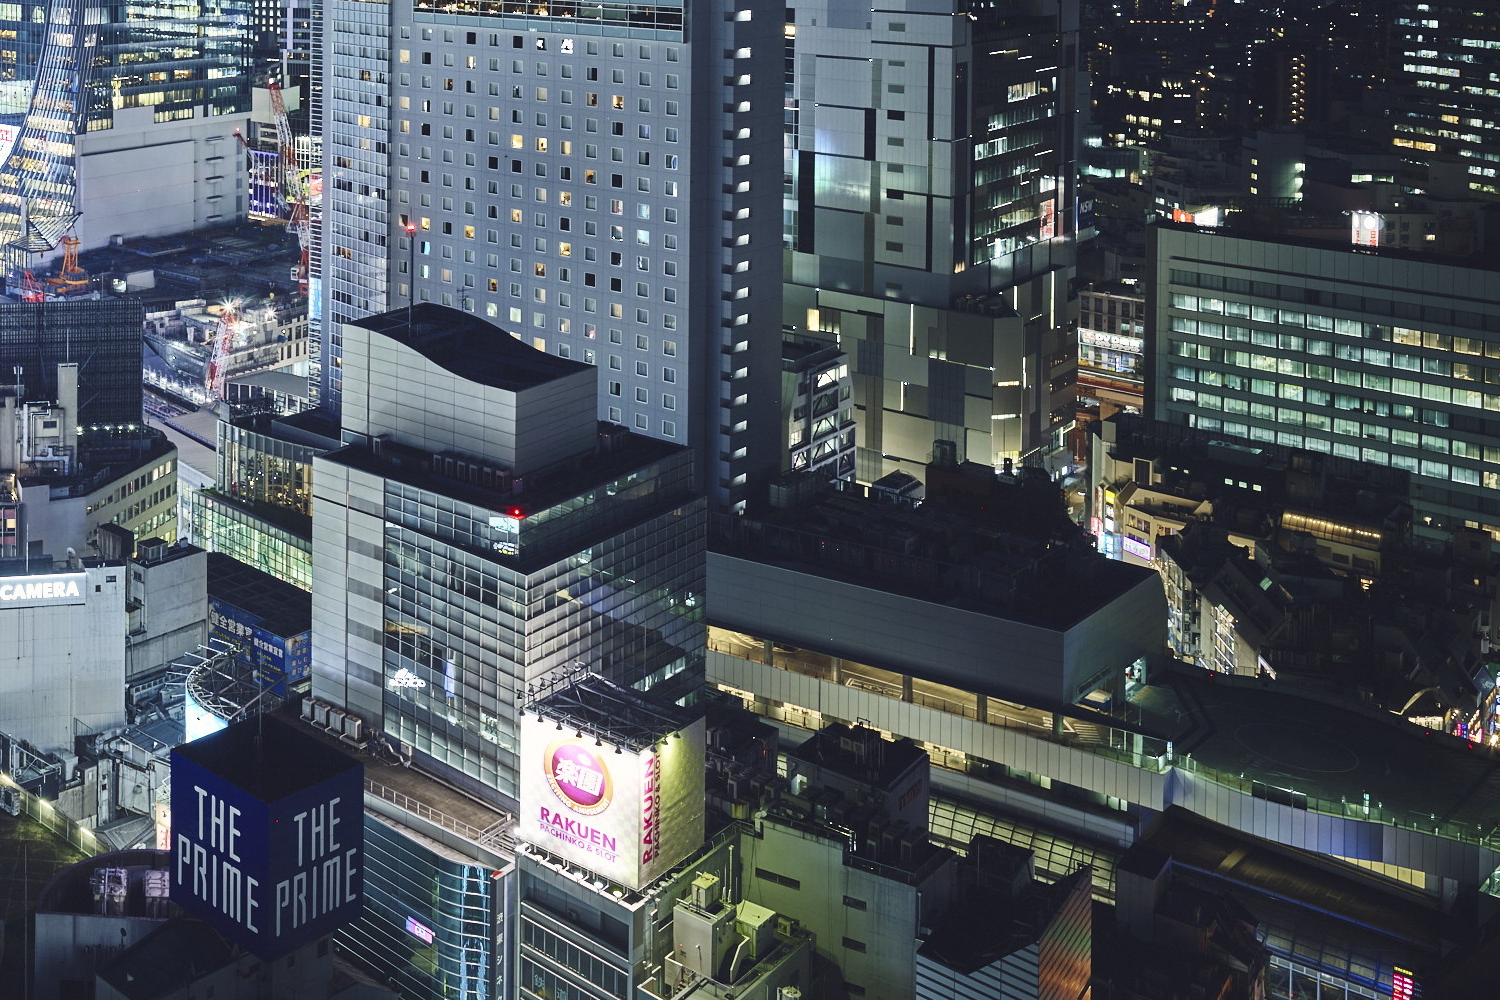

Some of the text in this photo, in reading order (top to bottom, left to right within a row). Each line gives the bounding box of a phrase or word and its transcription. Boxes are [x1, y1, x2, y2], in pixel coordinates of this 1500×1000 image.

[0, 580, 80, 601] CAMERA
[546, 773, 610, 816] EXCITING AMUSEMENT
[554, 757, 604, 797] 楽園
[194, 785, 241, 863] THE
[293, 797, 341, 867] THE
[540, 806, 616, 852] RAKUEN
[643, 757, 654, 865] RAKUEN
[540, 823, 616, 863] PACHINKO & SLOT
[178, 833, 259, 934] PRIME
[276, 848, 357, 937] PRIME
